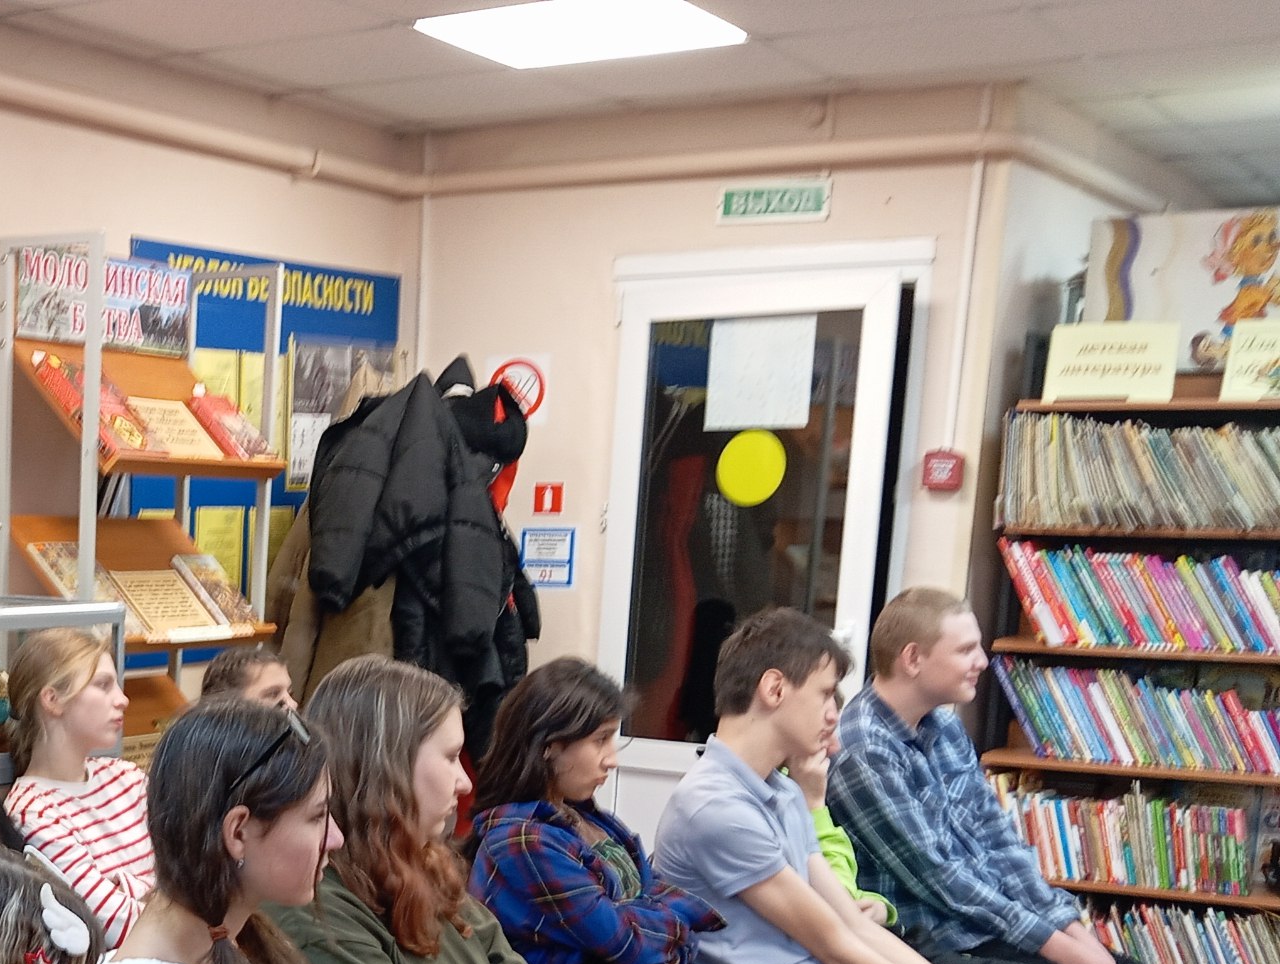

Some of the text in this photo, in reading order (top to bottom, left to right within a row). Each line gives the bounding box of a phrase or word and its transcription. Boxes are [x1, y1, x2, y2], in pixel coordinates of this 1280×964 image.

[21, 247, 188, 307] МОЛОИНСКАЯ
[246, 268, 375, 316] БЕОПАСНОСТИ
[70, 302, 144, 345] БТВА
